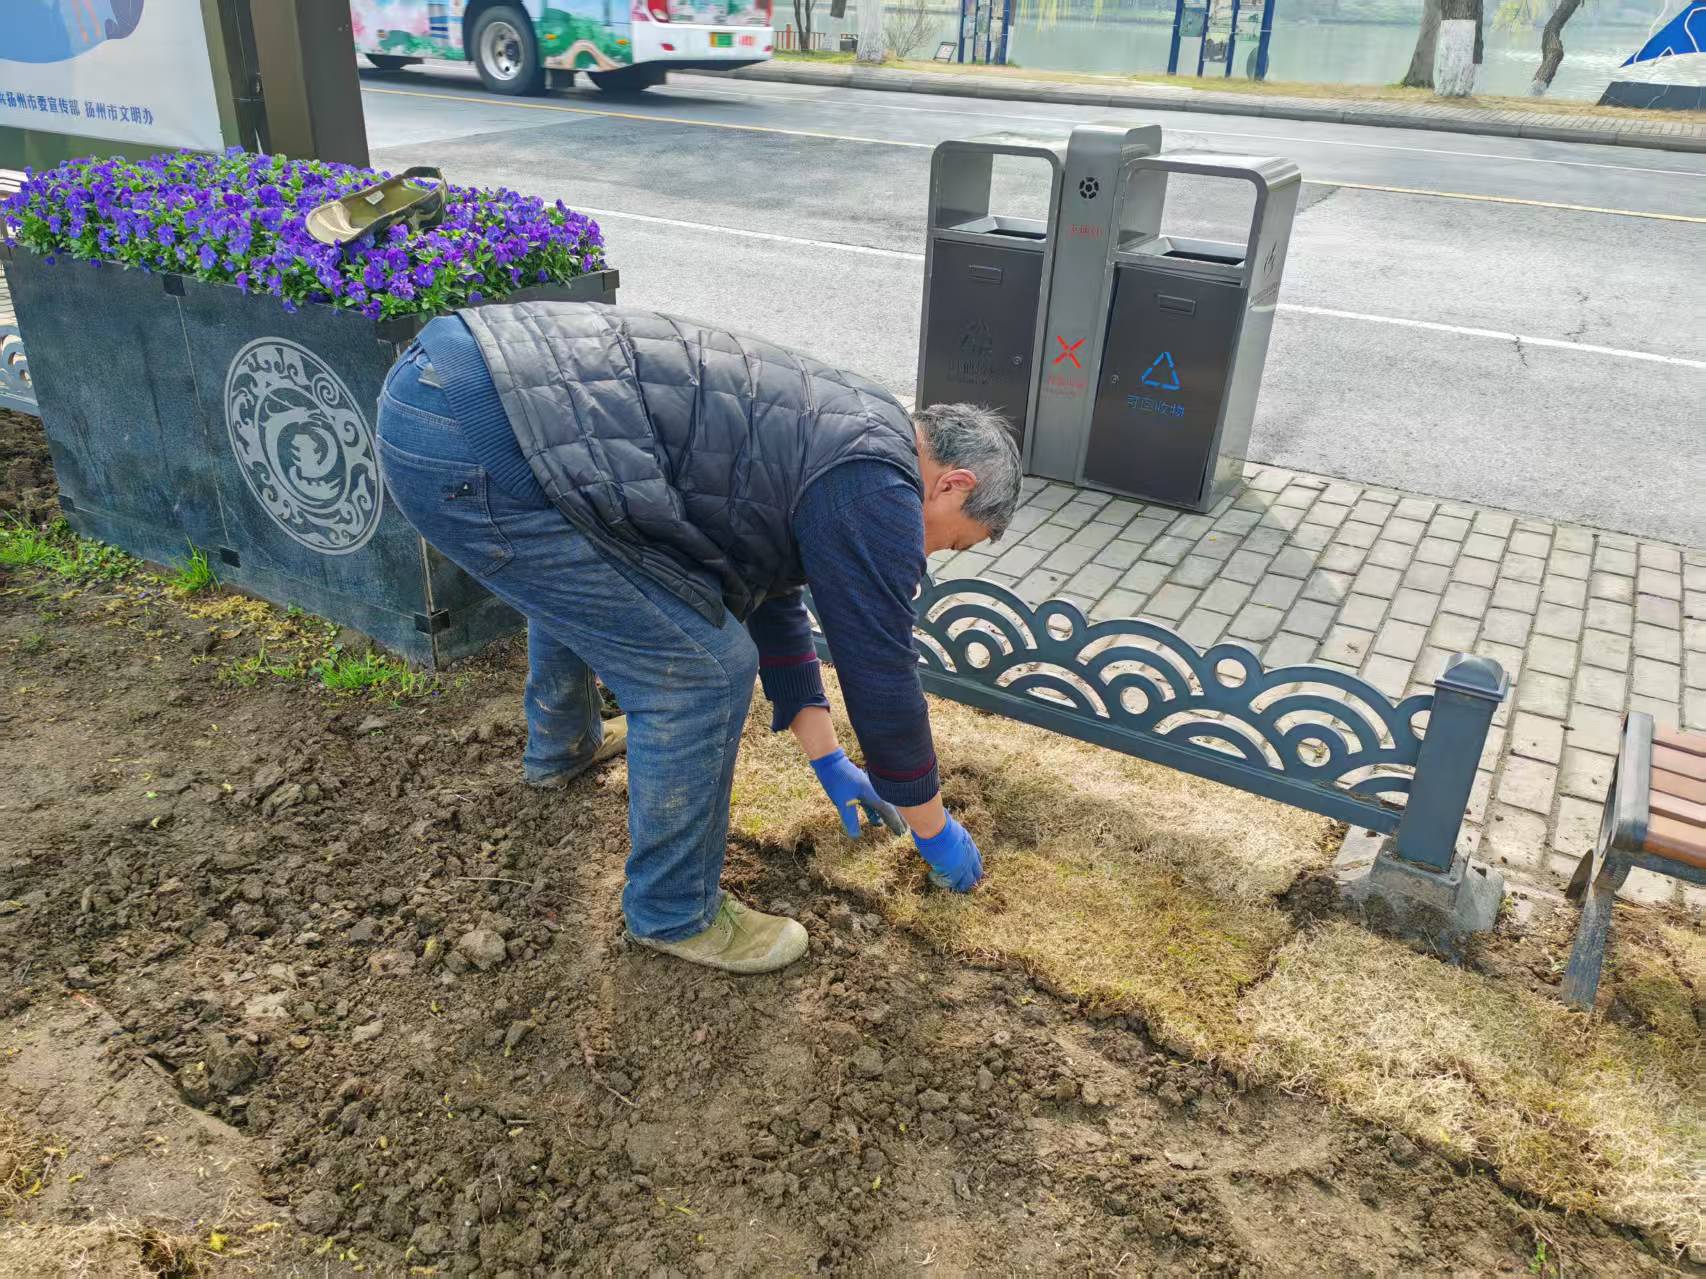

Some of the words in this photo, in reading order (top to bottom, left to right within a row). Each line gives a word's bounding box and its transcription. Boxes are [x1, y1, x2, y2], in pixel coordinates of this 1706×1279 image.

[85, 100, 154, 126] 扬州市文明办
